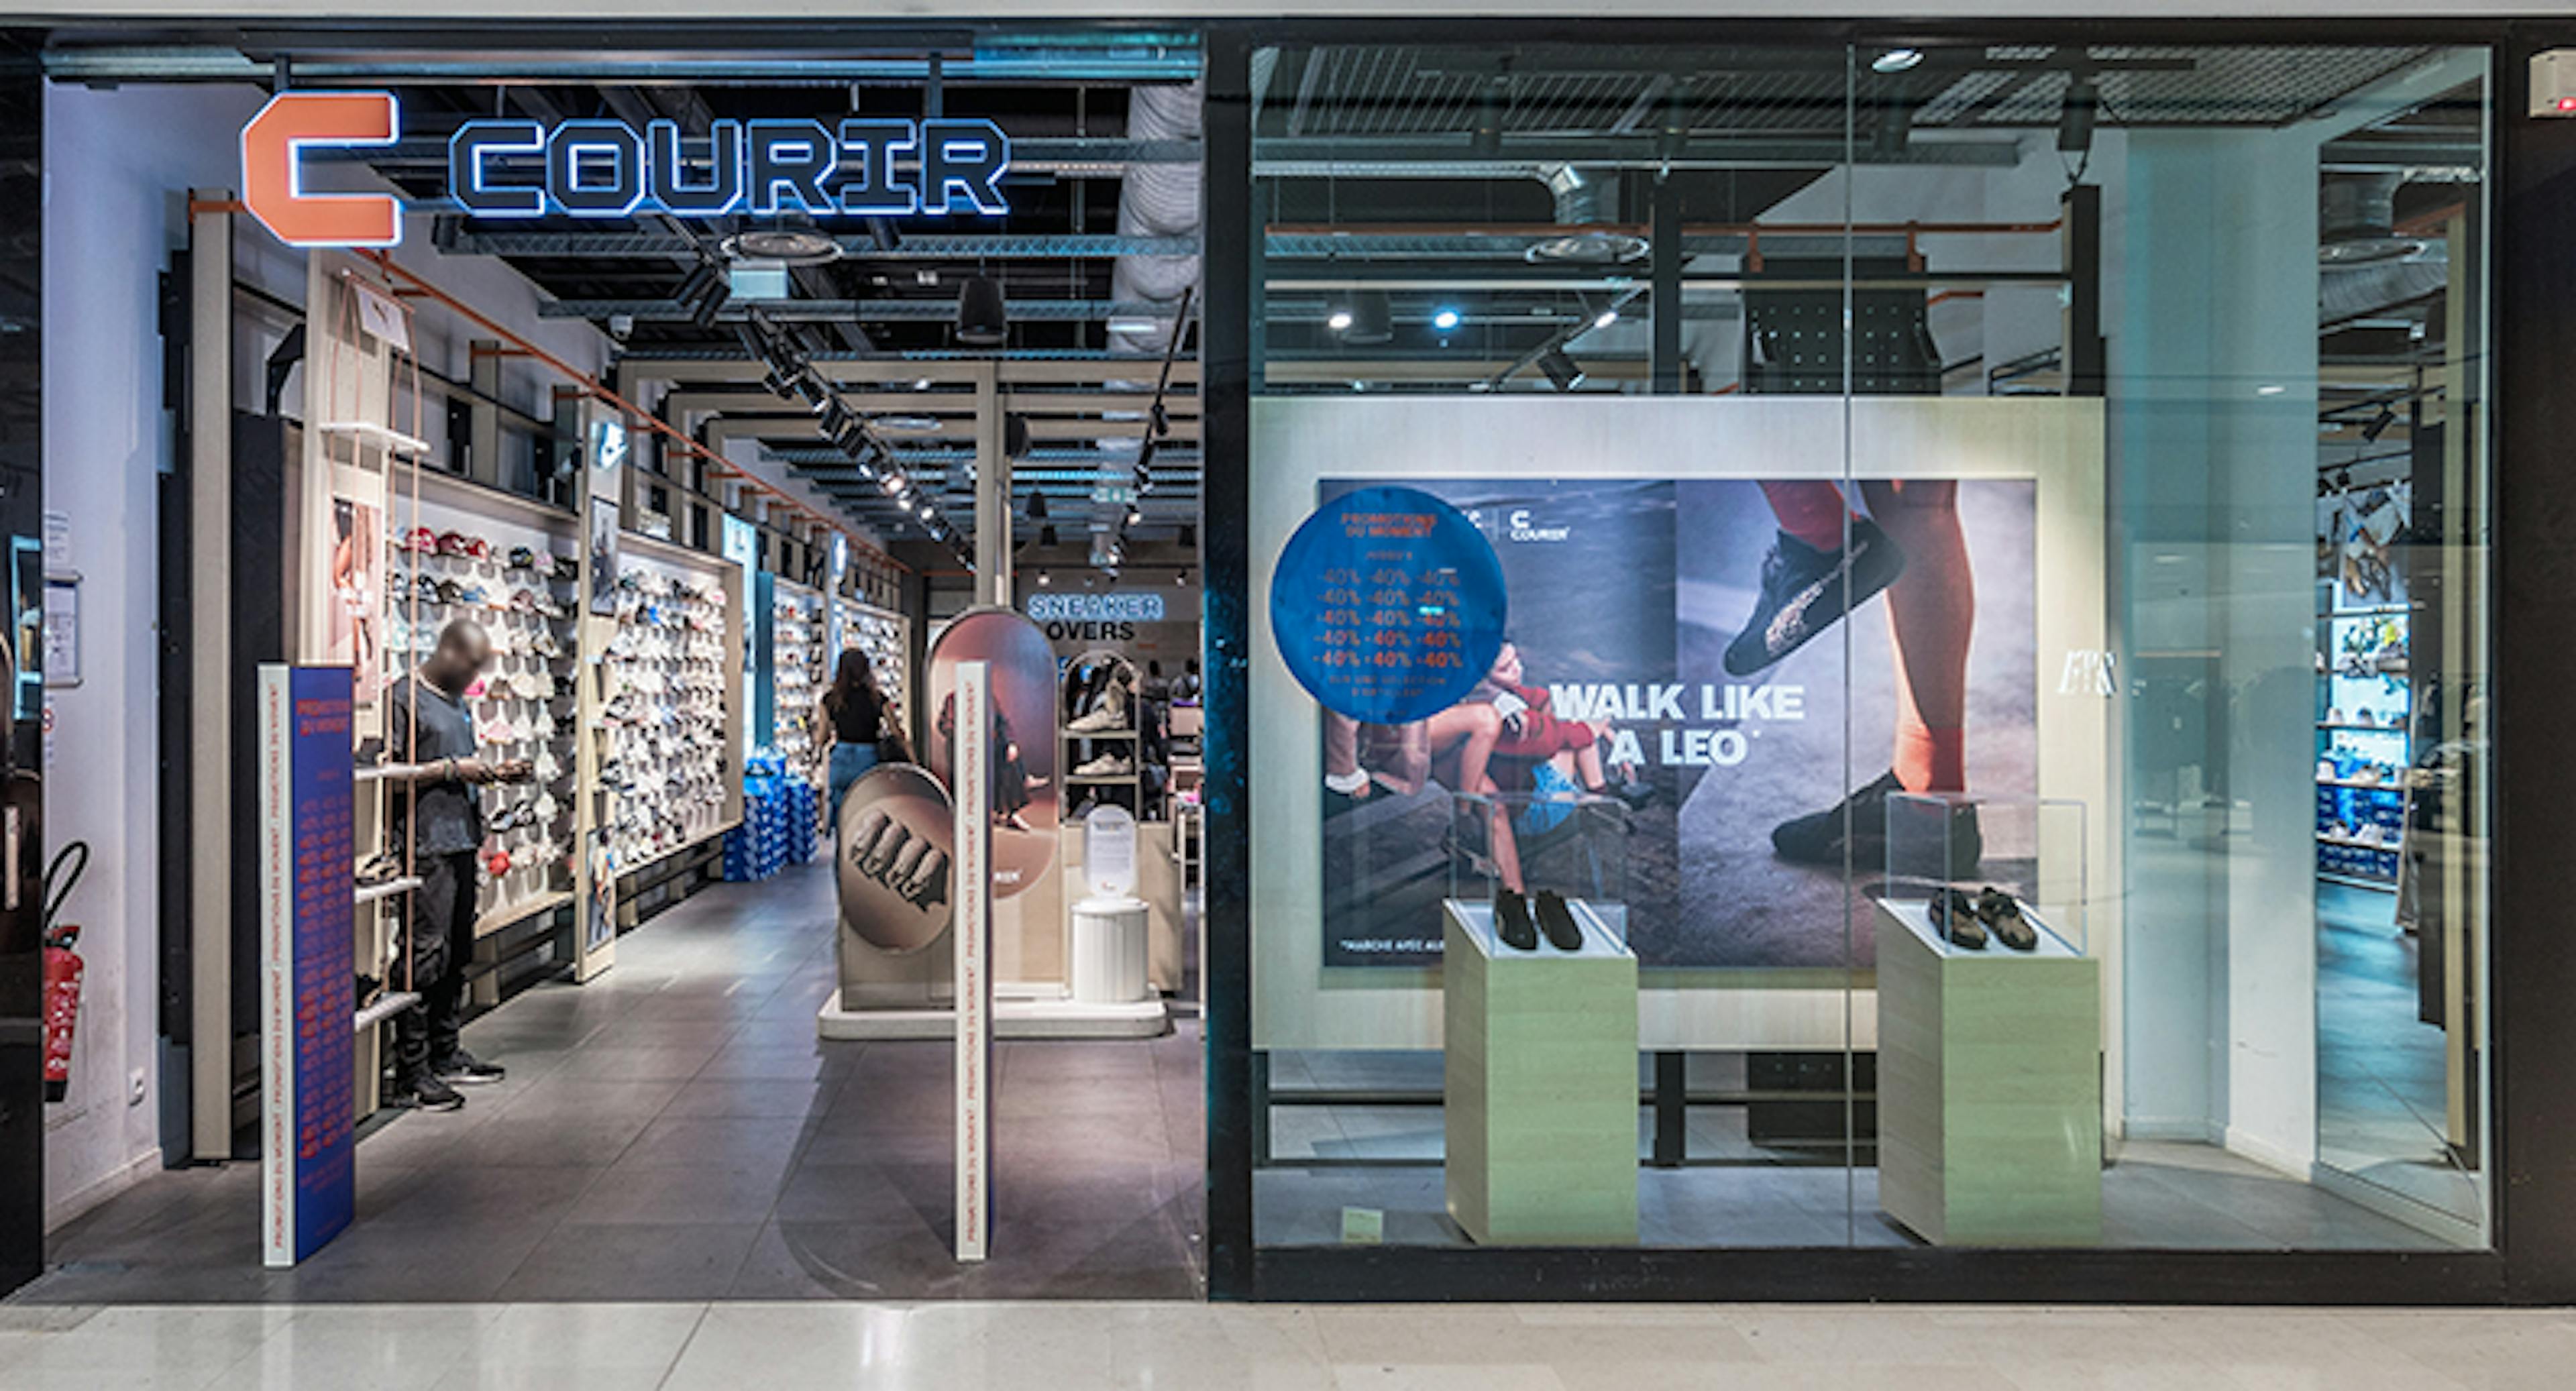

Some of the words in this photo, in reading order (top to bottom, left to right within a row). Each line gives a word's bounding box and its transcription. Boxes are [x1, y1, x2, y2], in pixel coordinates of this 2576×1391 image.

[449, 119, 1011, 217] COURIR
[1029, 594, 1163, 620] SNEAKER
[1046, 621, 1134, 641] OVERS
[1548, 684, 1687, 720] WALK
[1701, 684, 1806, 720] LIKE
[1607, 730, 1646, 765] A
